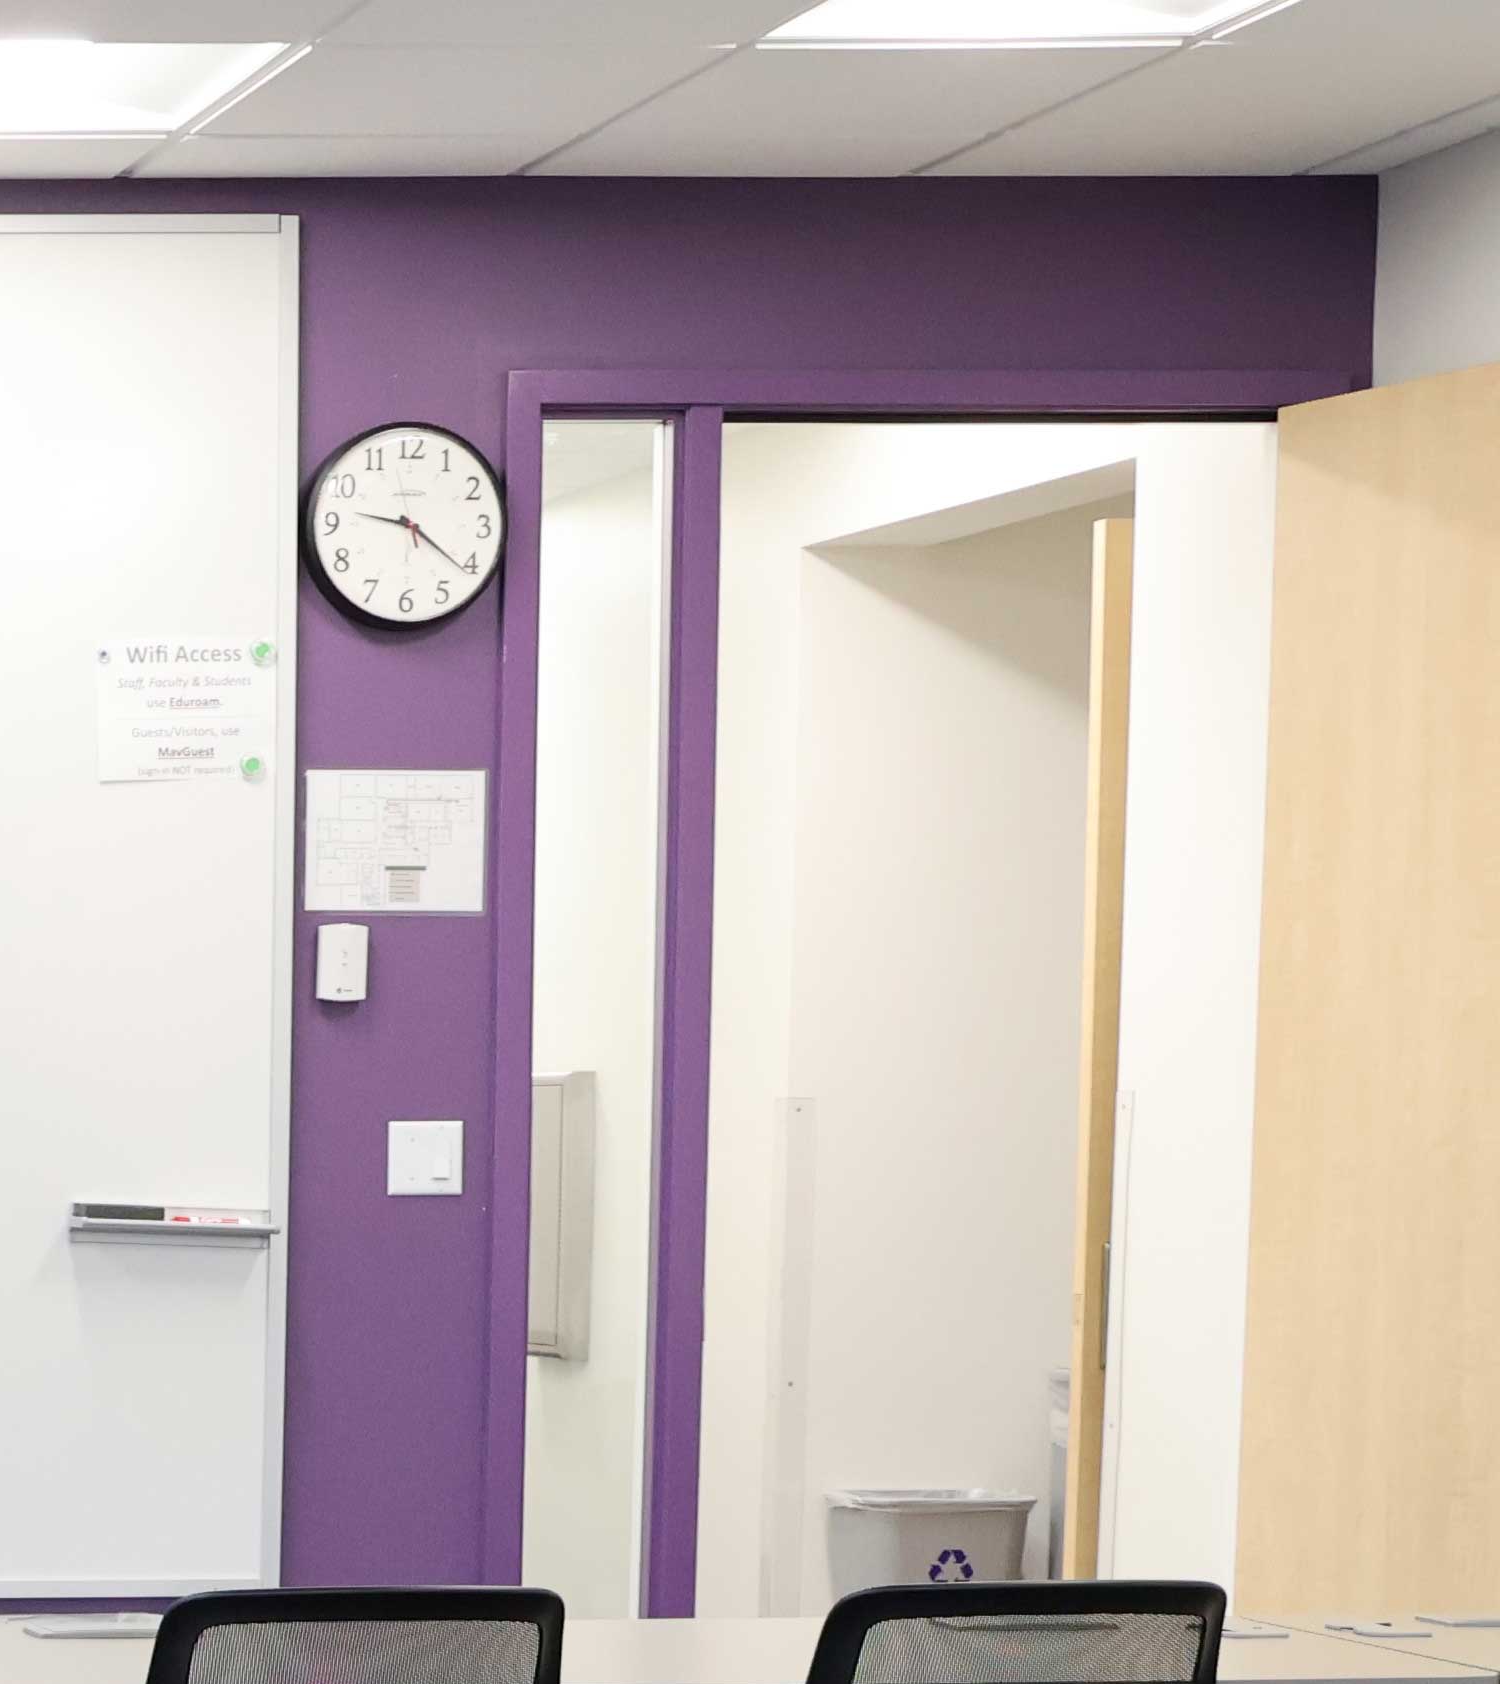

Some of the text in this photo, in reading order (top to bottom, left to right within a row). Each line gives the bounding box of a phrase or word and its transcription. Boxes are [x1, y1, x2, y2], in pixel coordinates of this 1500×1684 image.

[365, 448, 384, 471] 11
[399, 439, 425, 460] 12
[441, 449, 452, 471] 1
[331, 473, 356, 498] 10
[465, 477, 481, 501] 2
[324, 512, 339, 535] 9
[476, 515, 491, 538] 3
[334, 548, 350, 572] 8
[464, 552, 479, 574] 4
[362, 579, 379, 603] 7
[399, 589, 414, 612] 6
[434, 581, 450, 604] 5
[126, 645, 242, 664] Wifi Access
[117, 676, 251, 690] Staff, Faculty & Students
[147, 699, 166, 708] use
[221, 728, 240, 736] use
[158, 747, 215, 759] MavGuest
